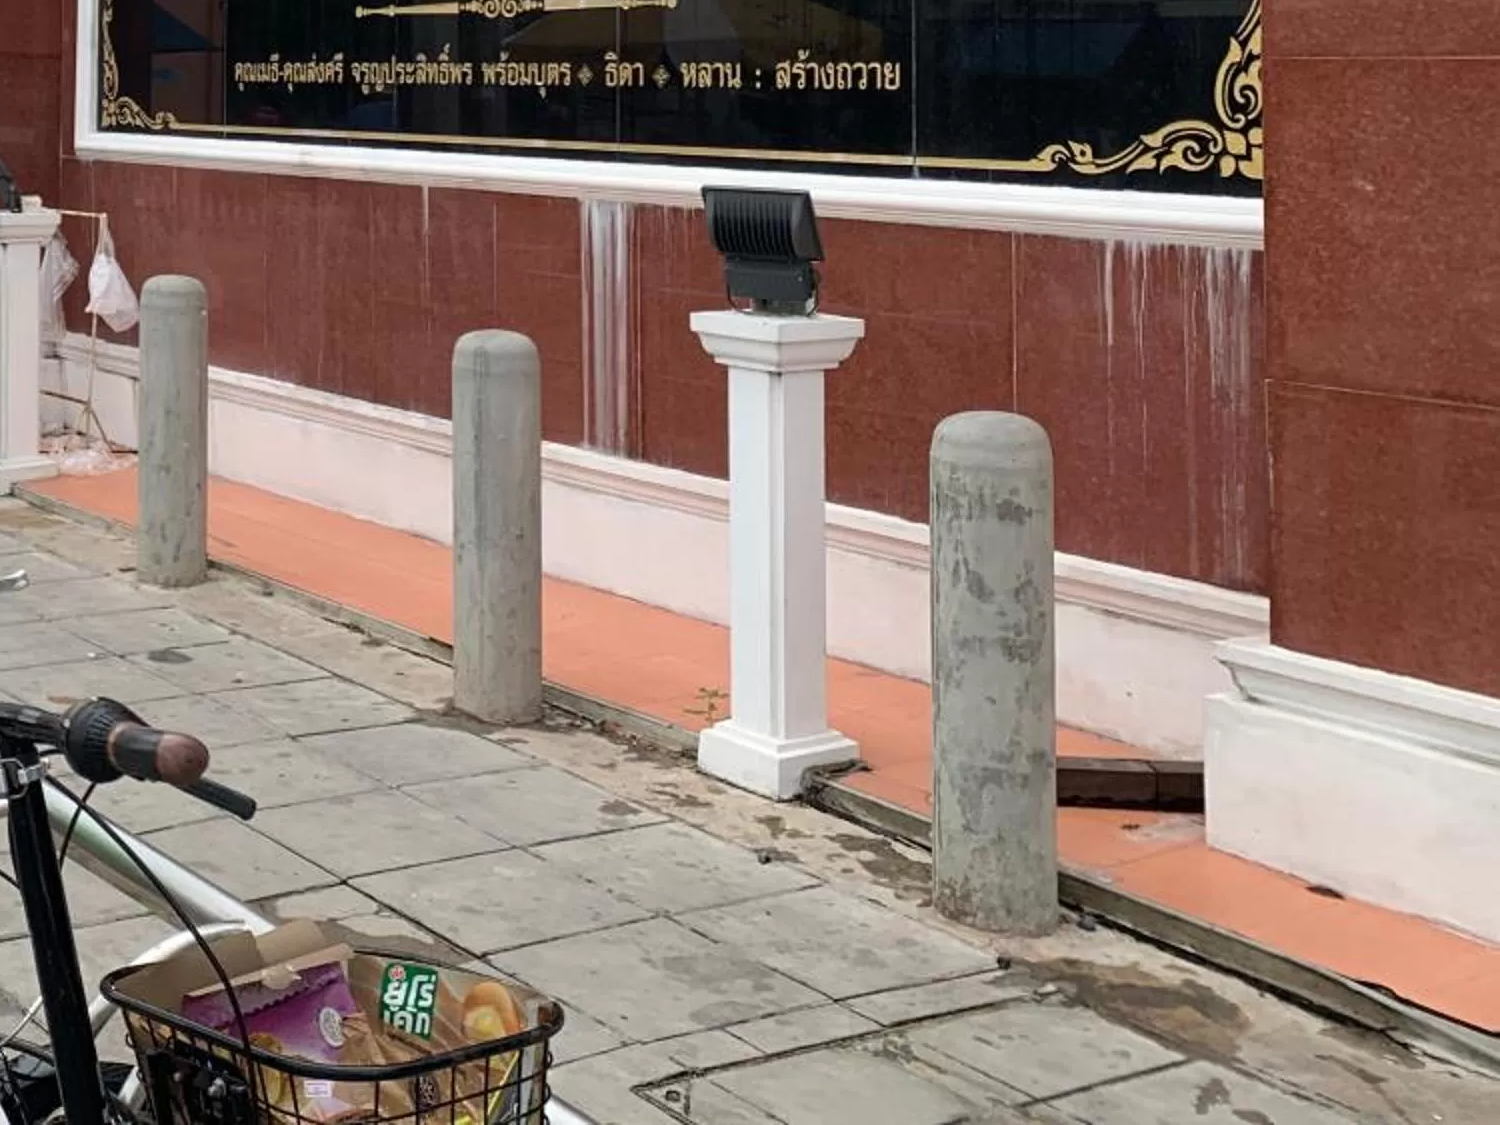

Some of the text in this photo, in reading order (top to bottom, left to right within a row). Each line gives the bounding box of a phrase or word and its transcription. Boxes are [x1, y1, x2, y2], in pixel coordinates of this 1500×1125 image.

[604, 50, 645, 89] ธิดา
[679, 60, 743, 90] หลาน
[774, 48, 901, 91] สร้างถวาย
